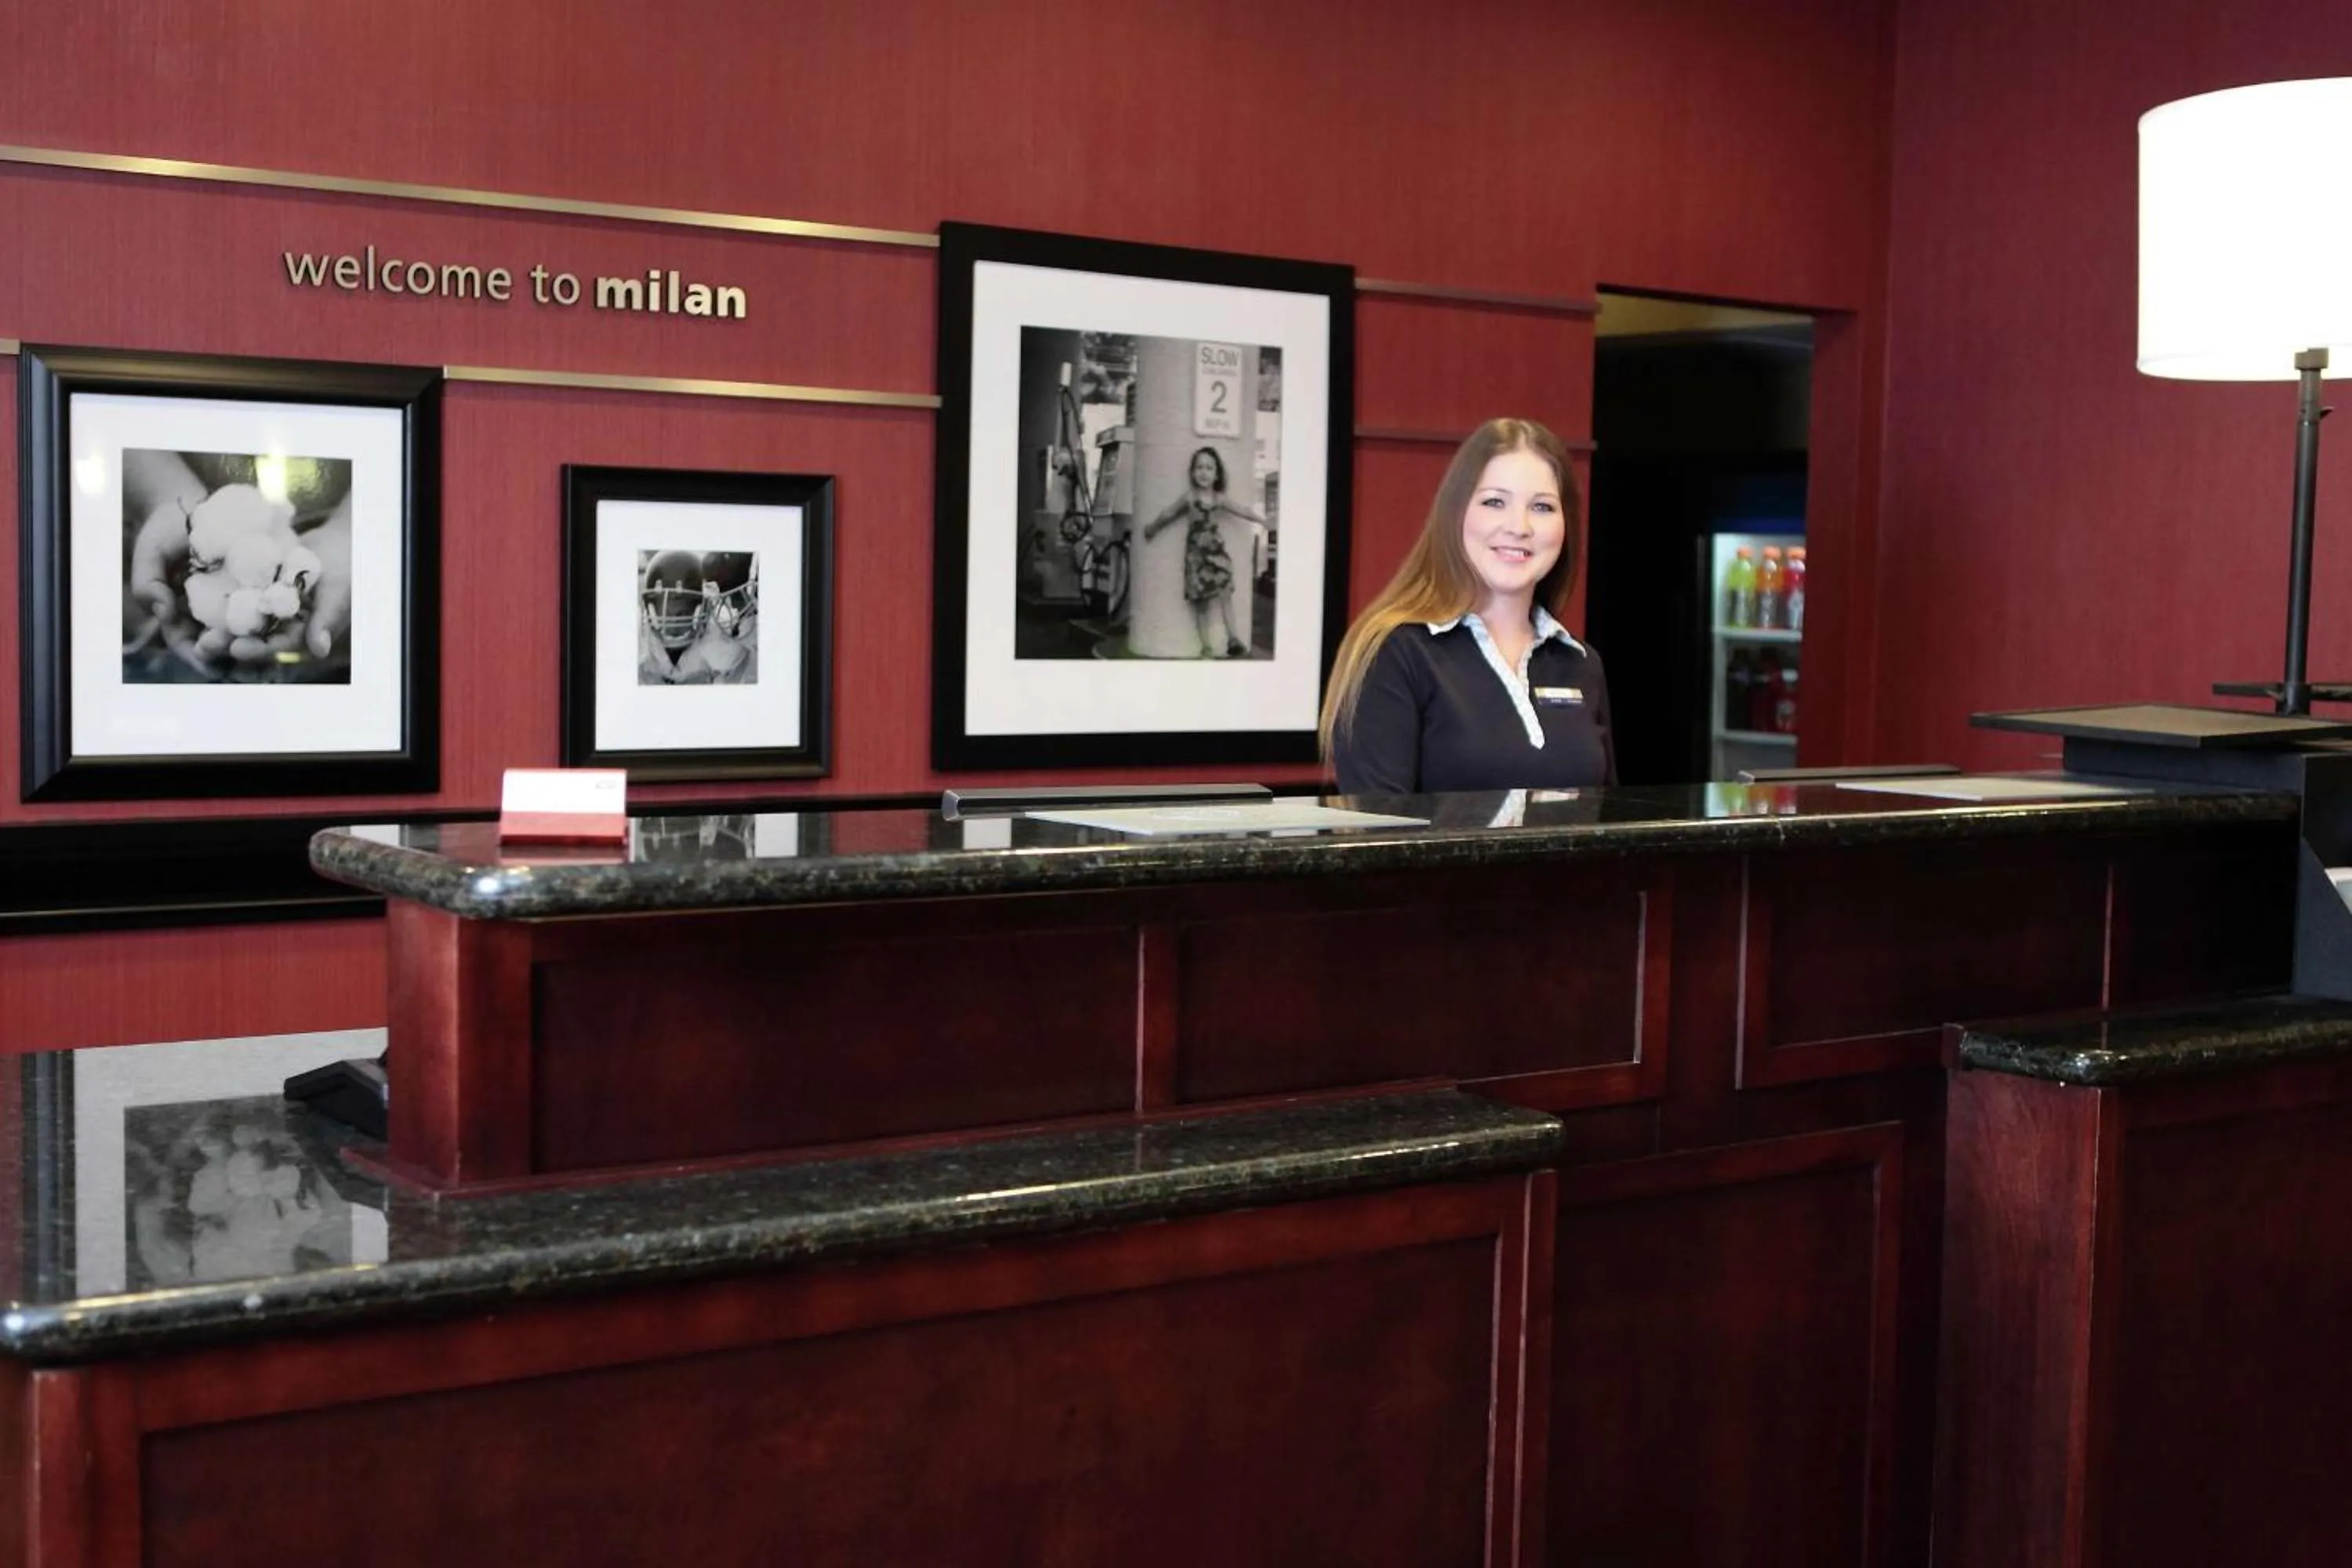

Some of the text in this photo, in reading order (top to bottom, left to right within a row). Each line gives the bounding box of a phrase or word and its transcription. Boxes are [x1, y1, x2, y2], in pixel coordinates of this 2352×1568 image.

[284, 245, 747, 318] welcome to milan
[1201, 347, 1239, 367] SLOW
[1210, 380, 1228, 414] 2
